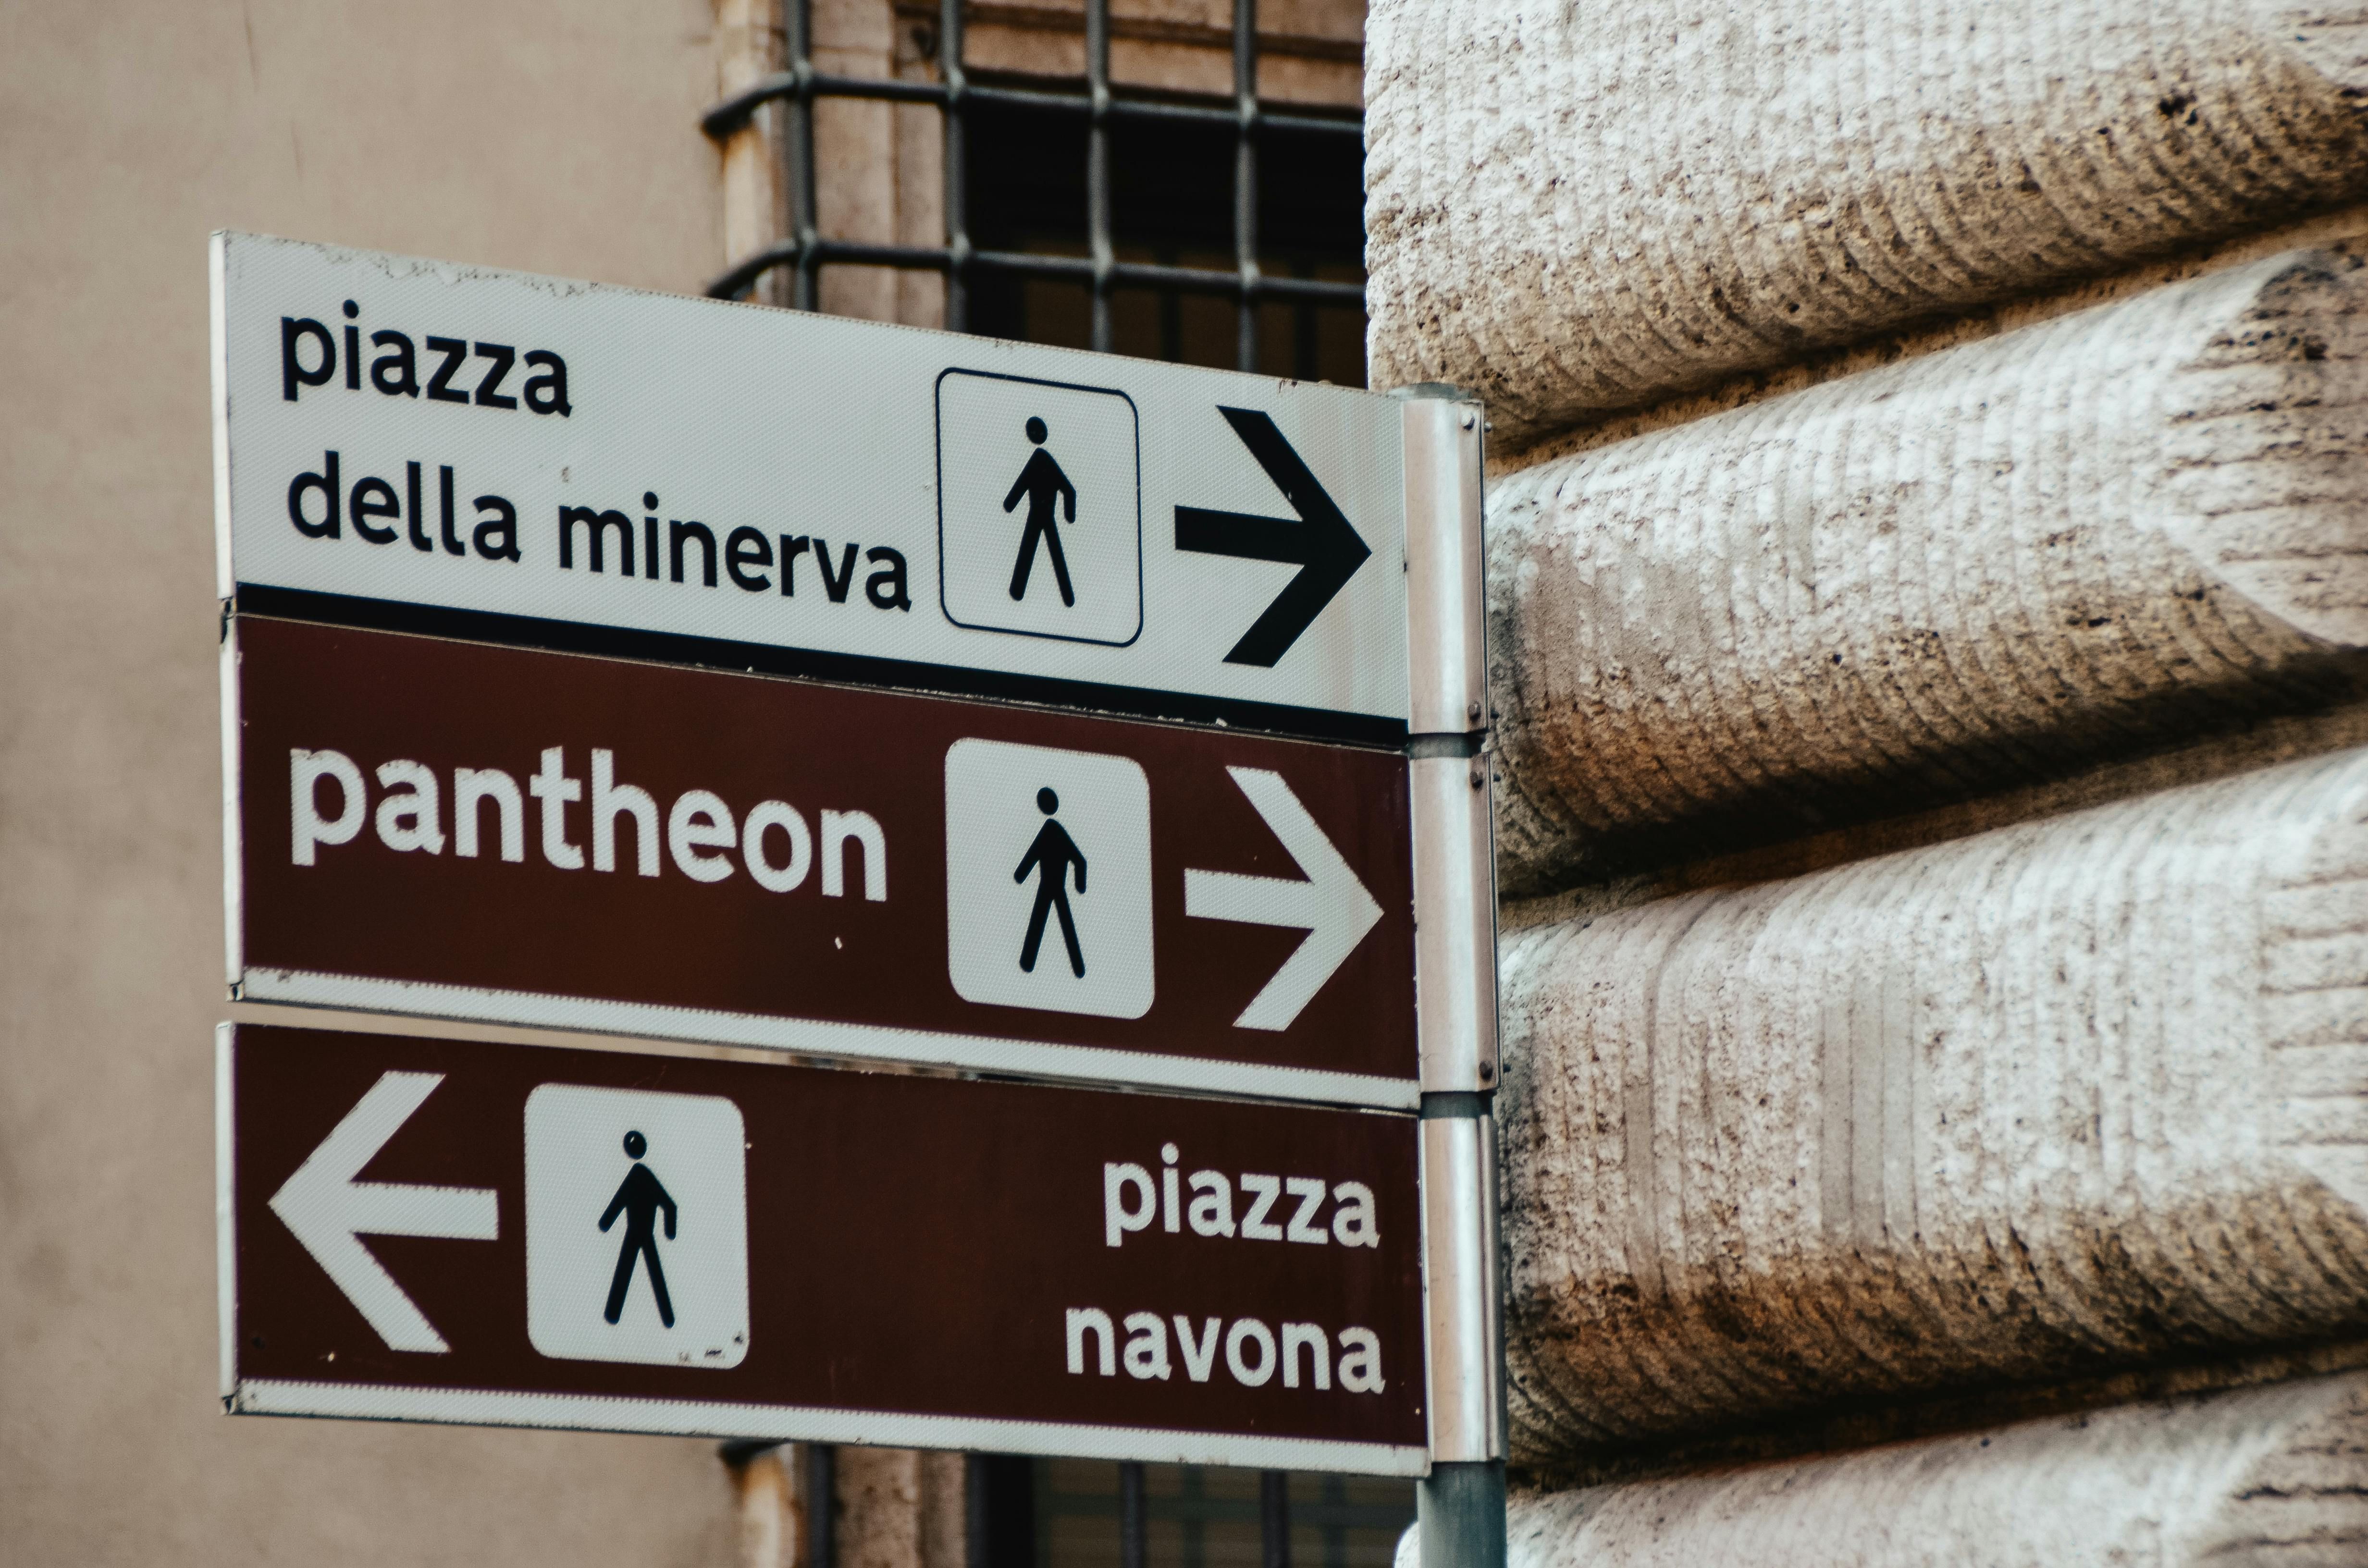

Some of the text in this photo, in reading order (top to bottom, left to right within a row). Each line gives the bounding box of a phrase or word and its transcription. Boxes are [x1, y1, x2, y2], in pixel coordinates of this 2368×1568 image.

[281, 299, 573, 418] piazza
[287, 450, 913, 613] della minerva
[290, 746, 887, 902] pantheon
[1104, 1142, 1381, 1249] piazza
[1065, 1307, 1386, 1394] navona
